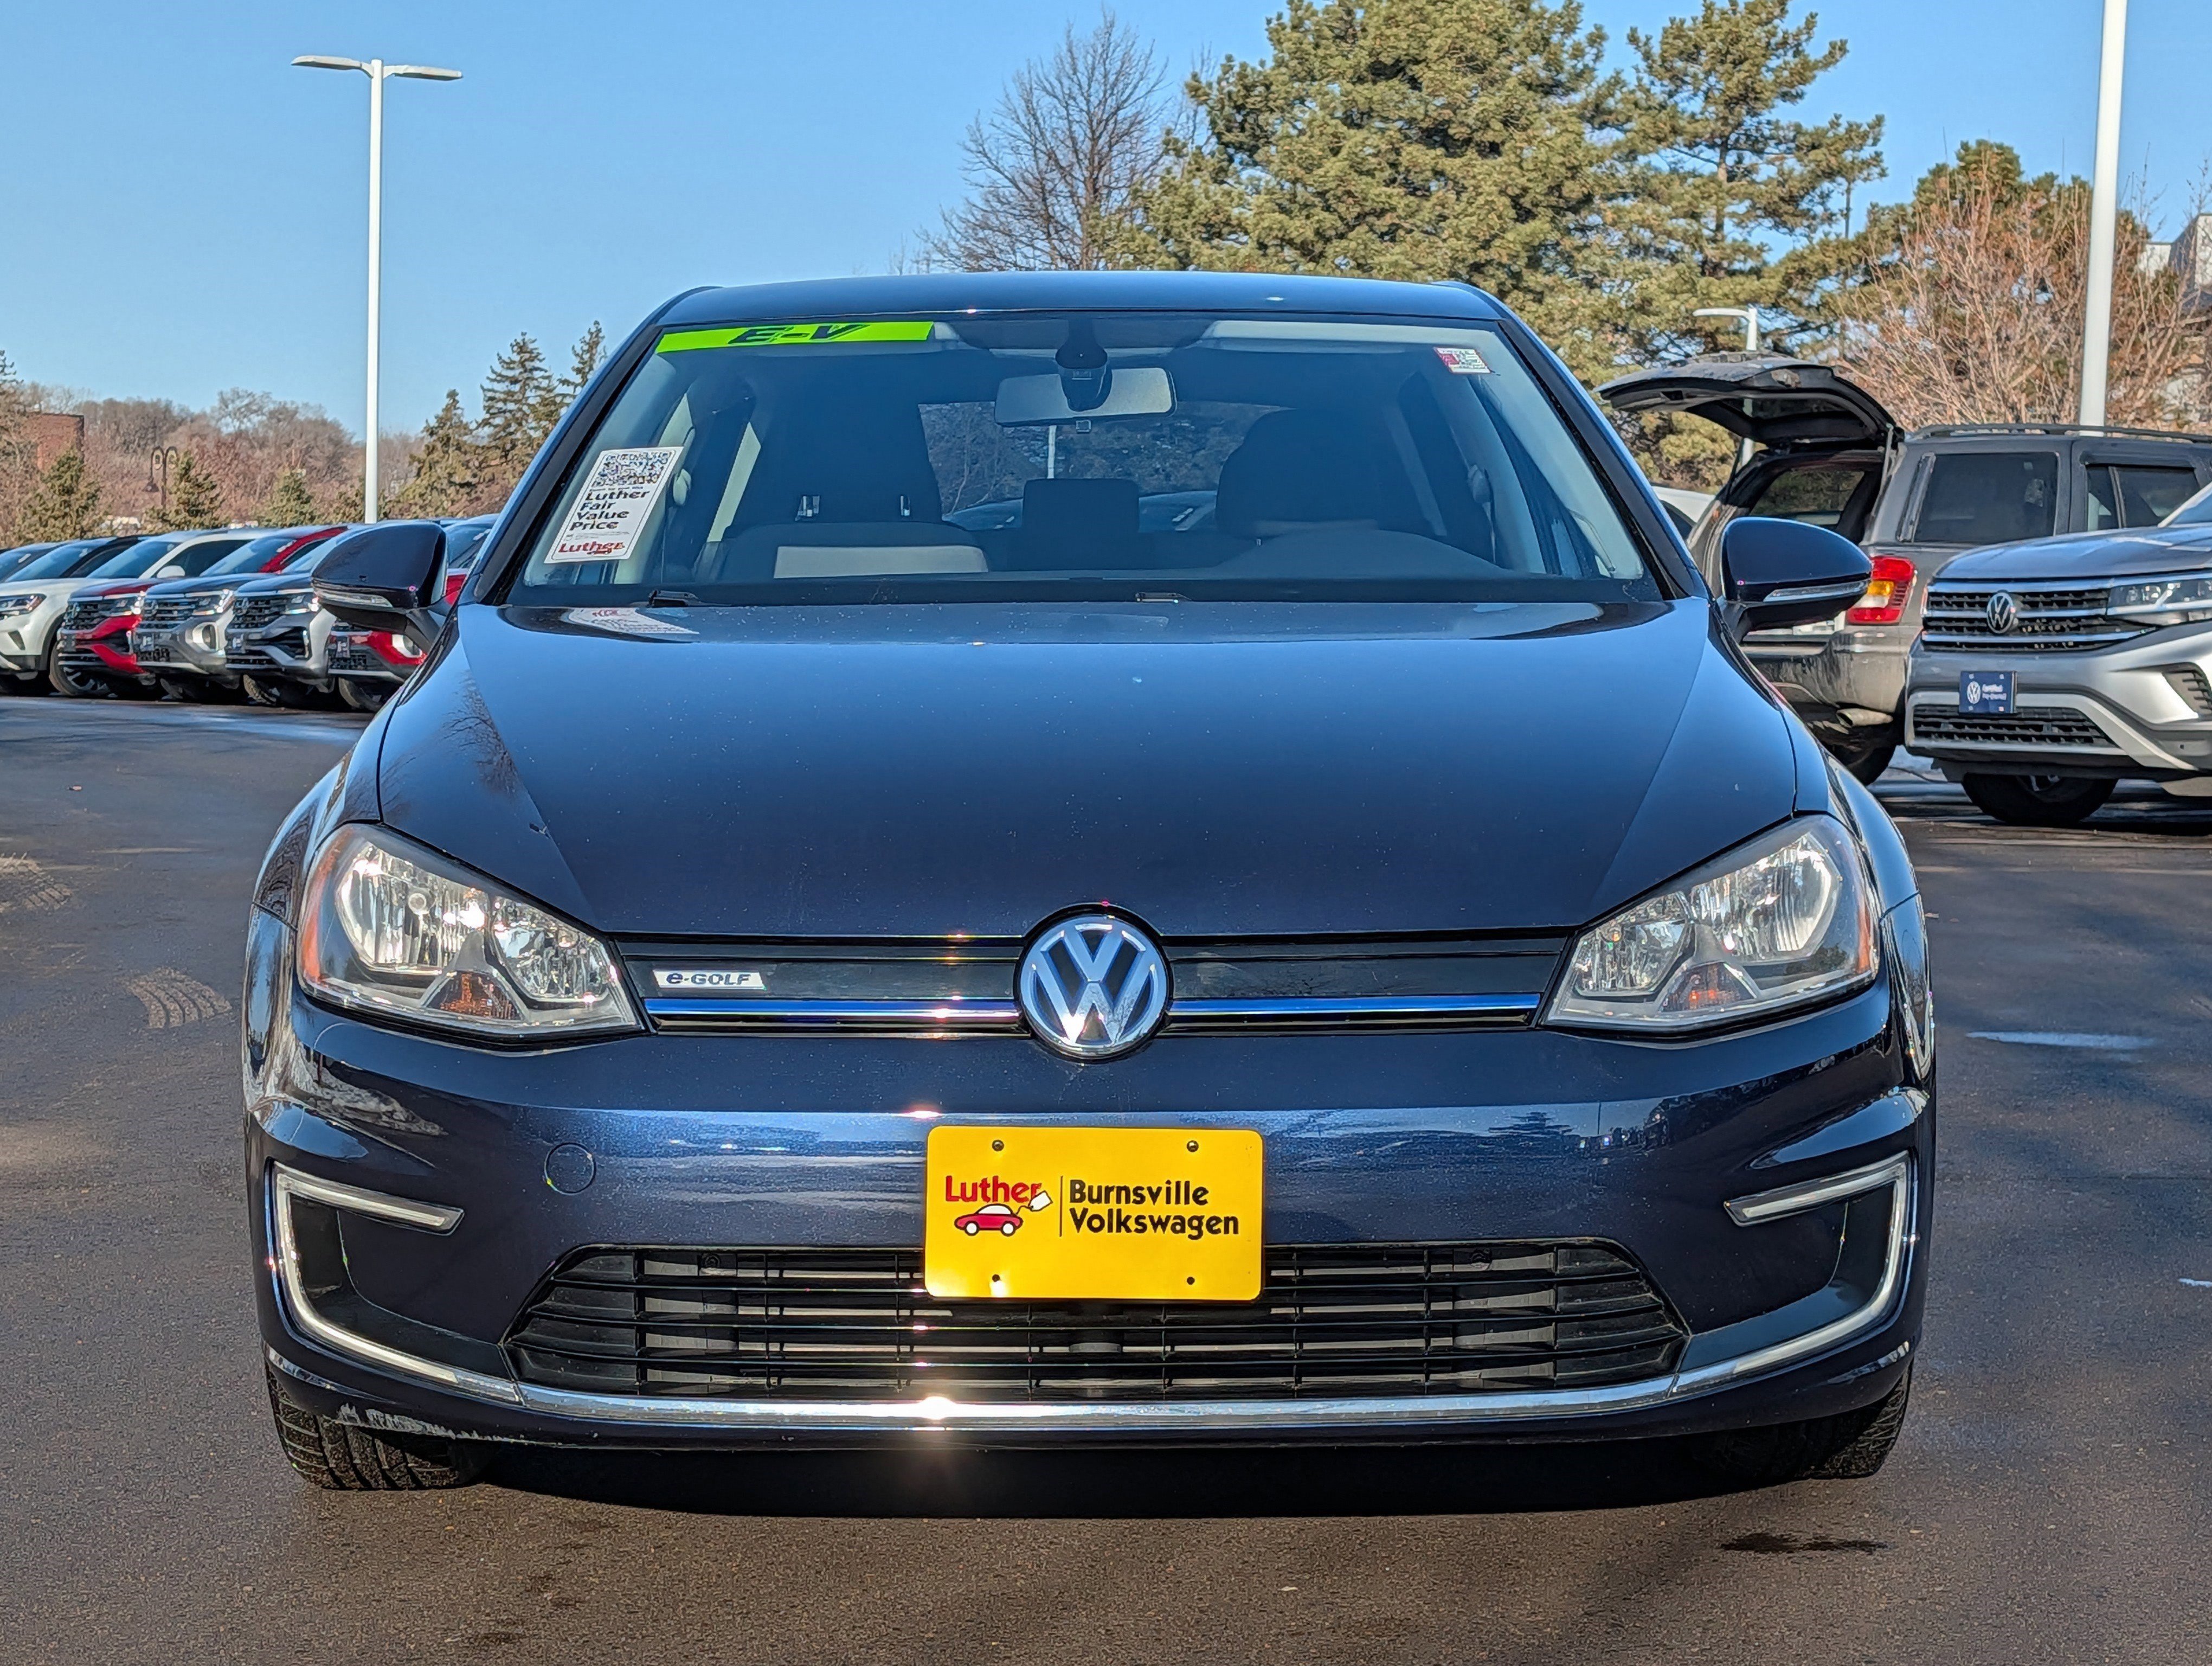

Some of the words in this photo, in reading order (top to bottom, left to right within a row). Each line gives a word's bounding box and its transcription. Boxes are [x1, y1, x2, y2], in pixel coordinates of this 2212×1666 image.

[585, 490, 650, 501] Luther
[580, 501, 616, 511] Fair
[576, 510, 630, 520] Value
[666, 972, 751, 985] e-GOLF
[945, 1175, 1043, 1203] Luther
[1069, 1179, 1210, 1206] Burnsville
[1069, 1207, 1239, 1240] Volkswagen
